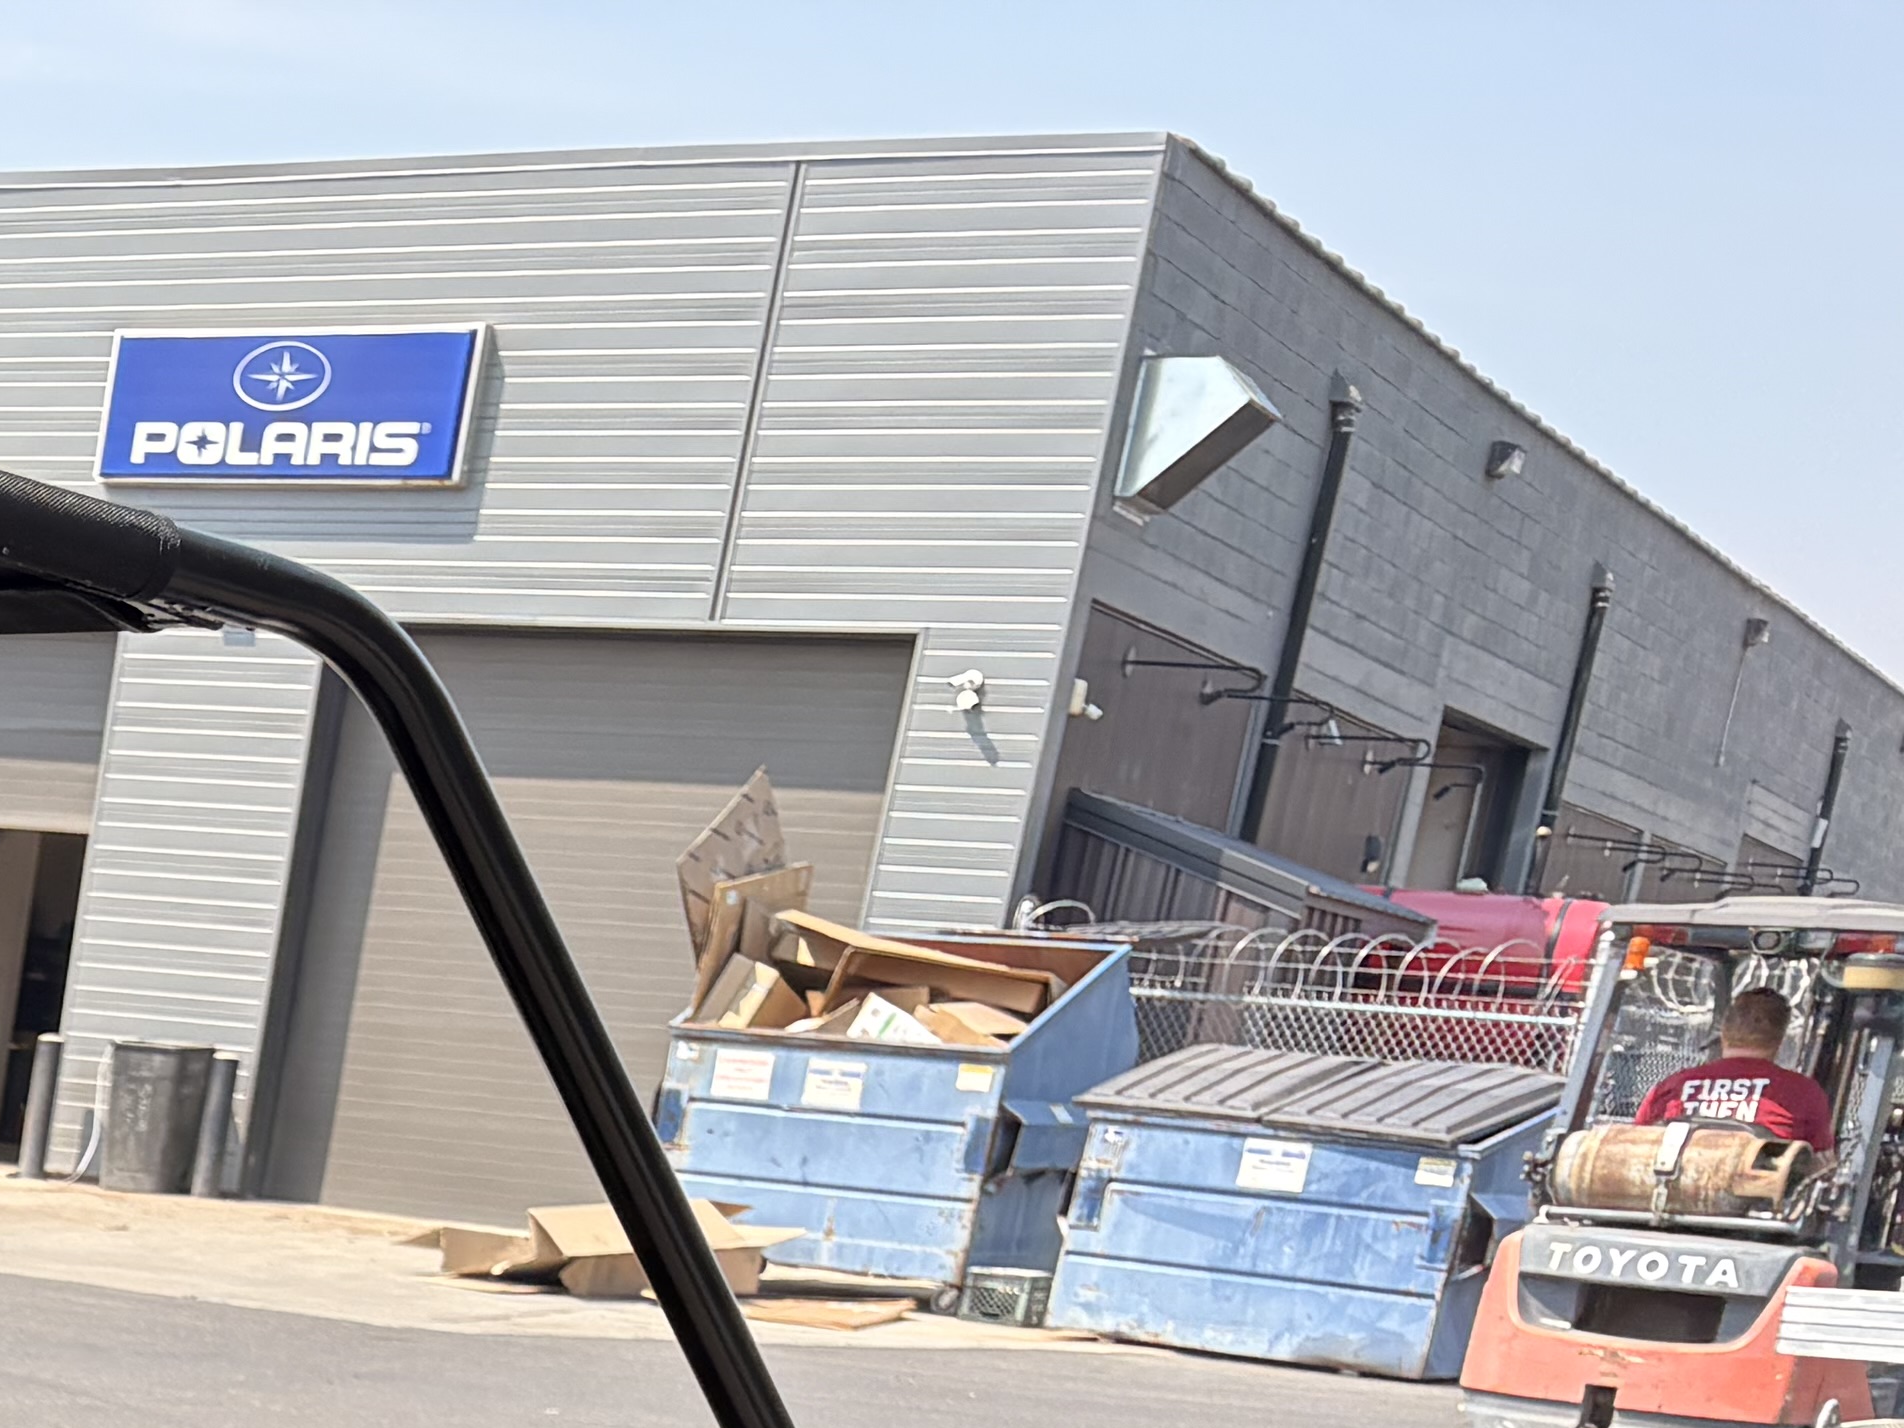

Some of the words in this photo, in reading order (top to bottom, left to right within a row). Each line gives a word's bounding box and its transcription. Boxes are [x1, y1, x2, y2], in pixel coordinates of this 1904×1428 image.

[129, 421, 422, 466] POLARIS
[1680, 1078, 1770, 1101] FIRST
[1549, 1242, 1739, 1289] TOYOTA
